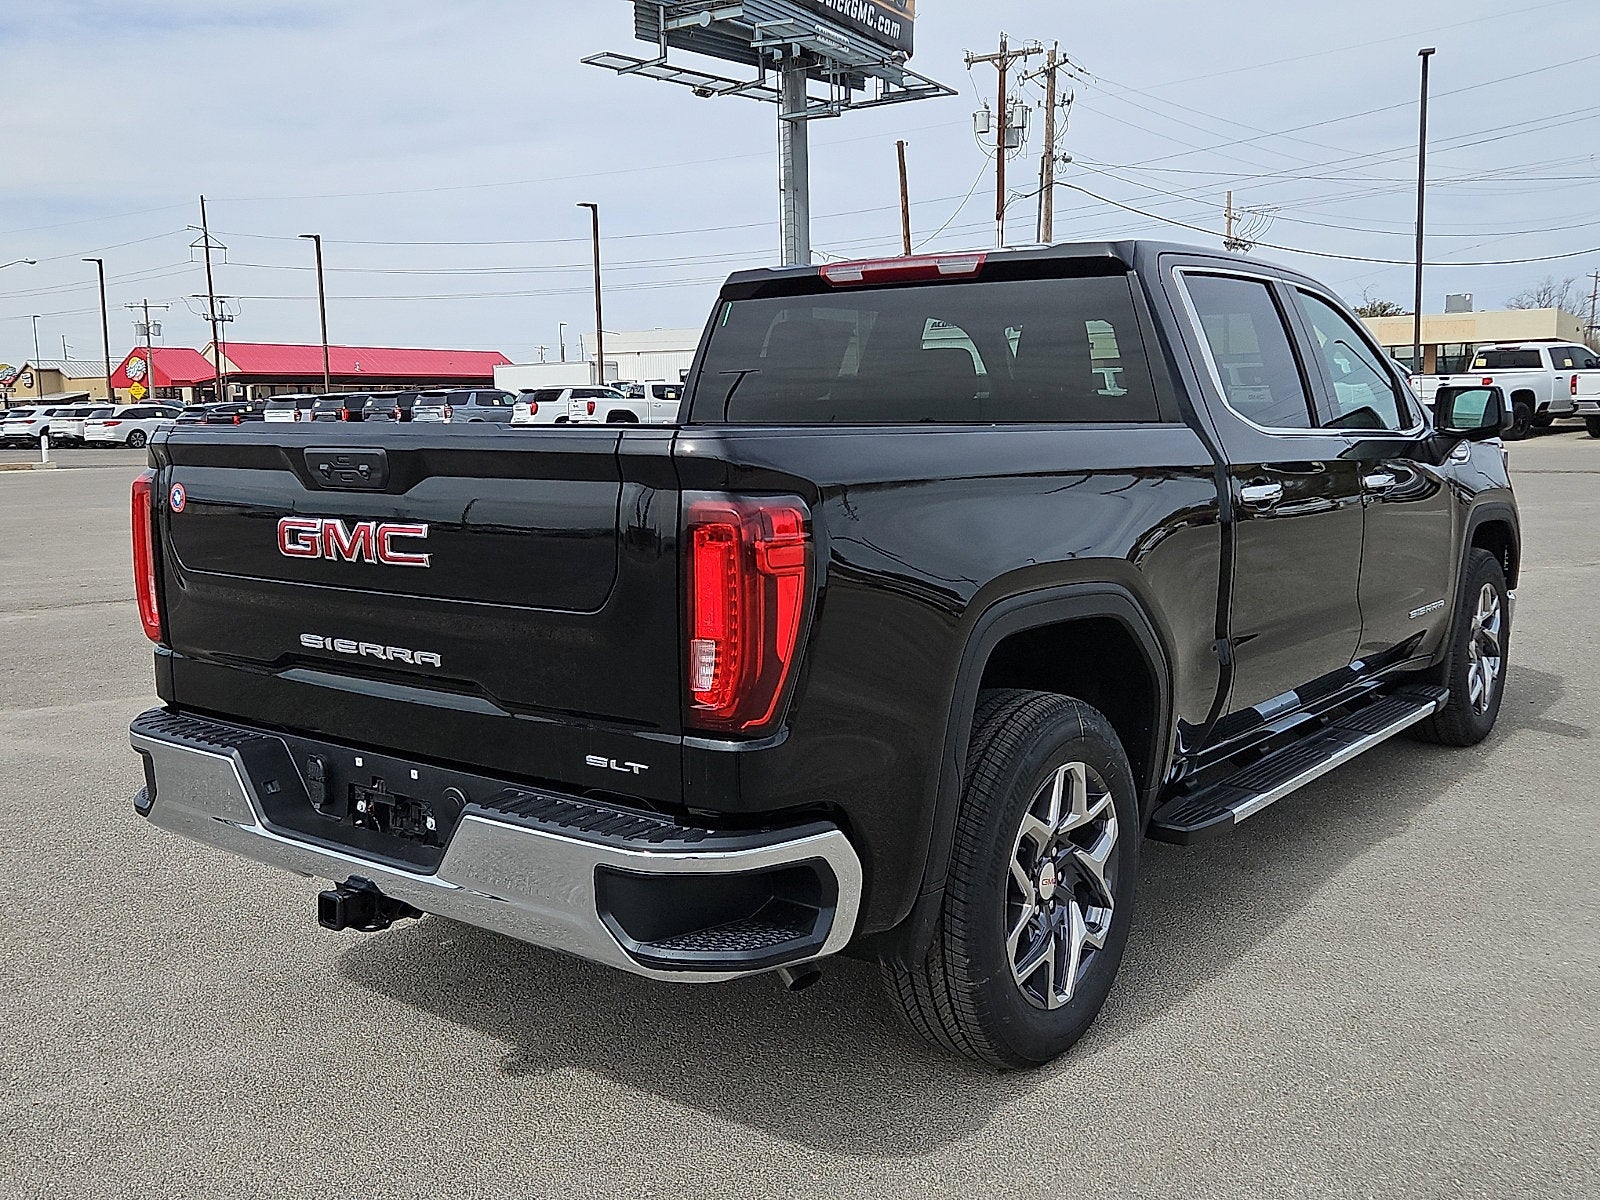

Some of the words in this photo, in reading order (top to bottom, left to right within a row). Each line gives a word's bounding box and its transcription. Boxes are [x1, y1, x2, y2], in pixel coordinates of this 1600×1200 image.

[817, 0, 900, 39] ickGMC.com
[278, 516, 433, 568] GMC
[1409, 599, 1445, 619] SIERRA
[300, 633, 441, 668] SIERRA
[585, 755, 649, 774] SLT
